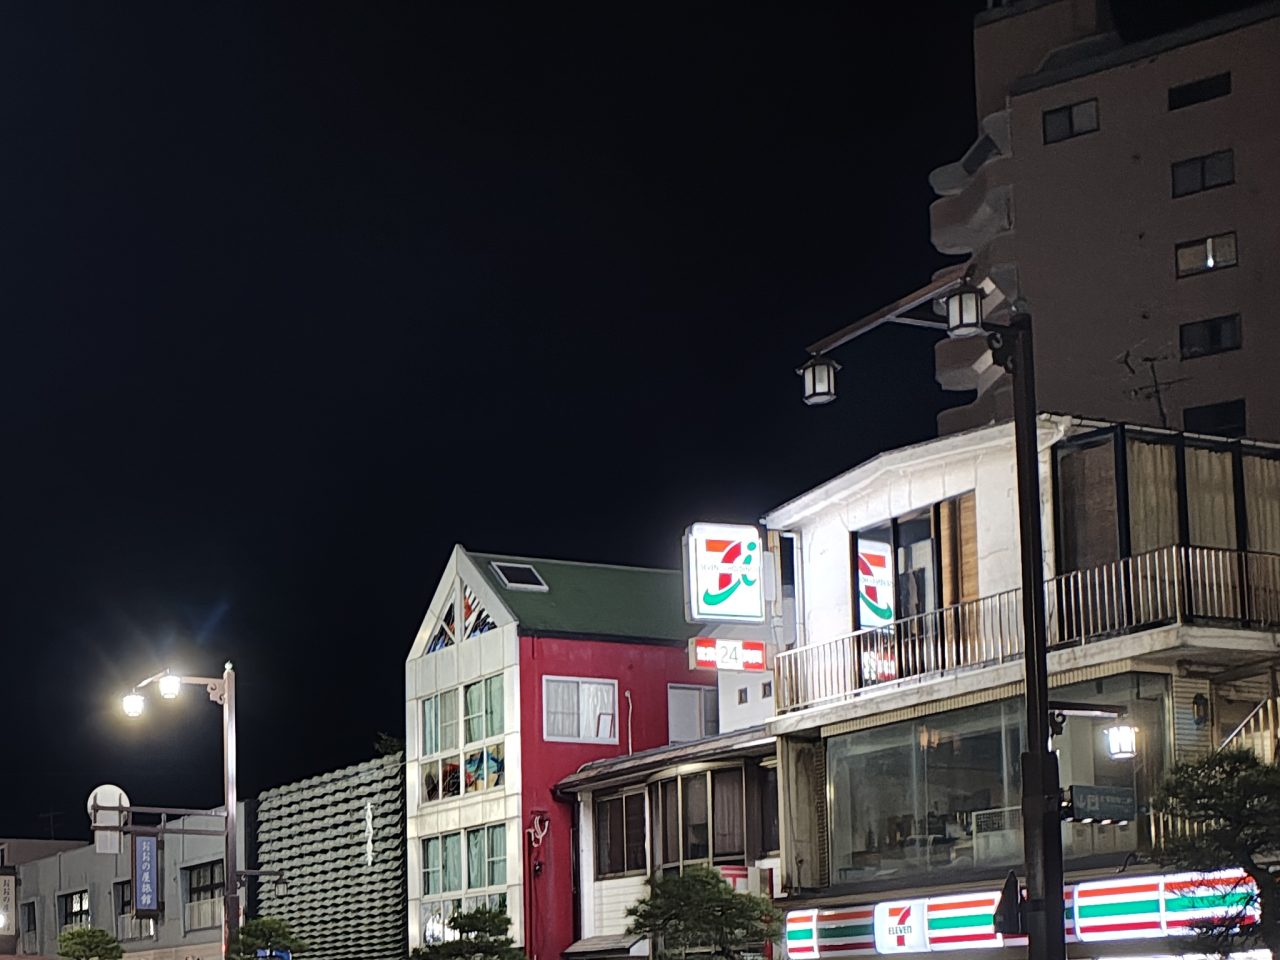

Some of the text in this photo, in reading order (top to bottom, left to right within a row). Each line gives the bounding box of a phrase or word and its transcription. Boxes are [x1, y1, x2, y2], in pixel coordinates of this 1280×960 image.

[720, 645, 738, 664] 24
[141, 841, 152, 905] おおの屋旅館
[888, 905, 912, 946] 7
